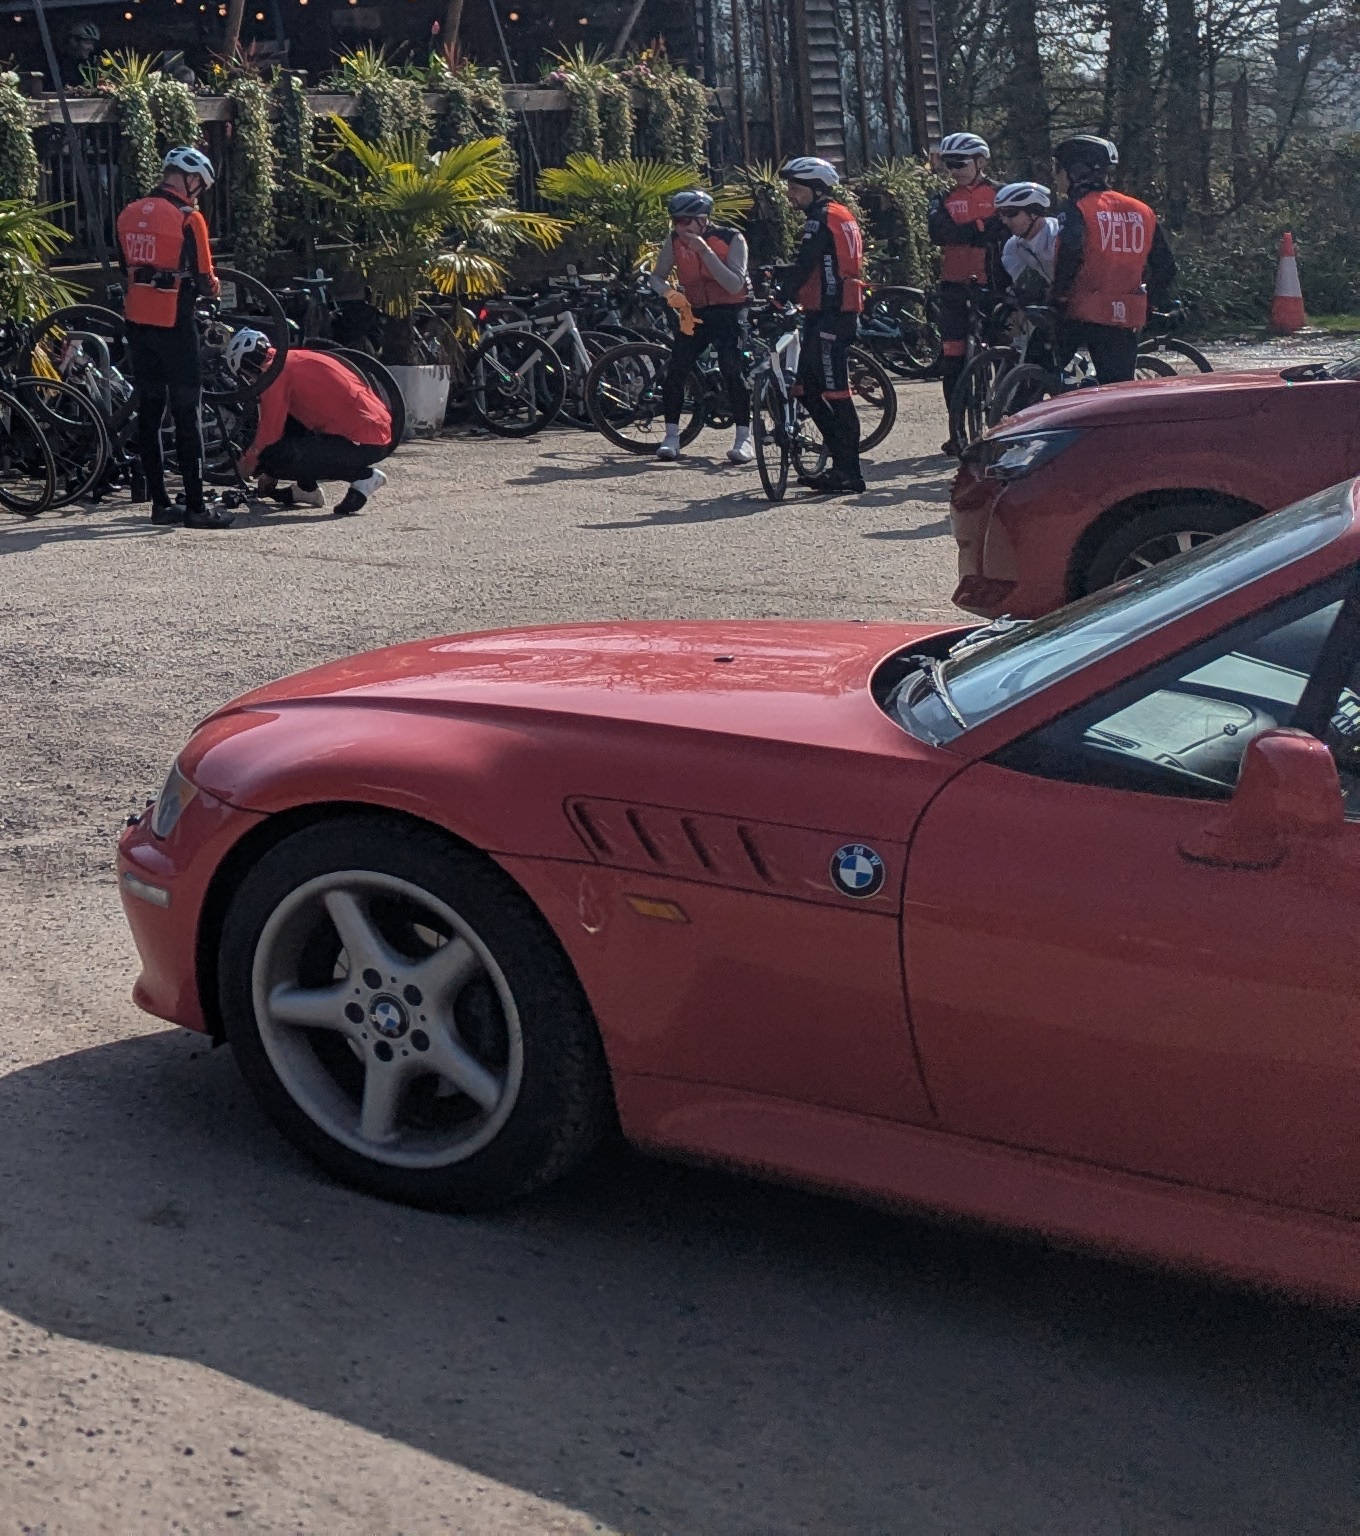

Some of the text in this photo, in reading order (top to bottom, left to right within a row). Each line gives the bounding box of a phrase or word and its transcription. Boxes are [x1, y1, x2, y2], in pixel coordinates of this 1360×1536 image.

[1098, 219, 1145, 254] VELO
[126, 240, 156, 262] VELO
[837, 846, 881, 866] BMW
